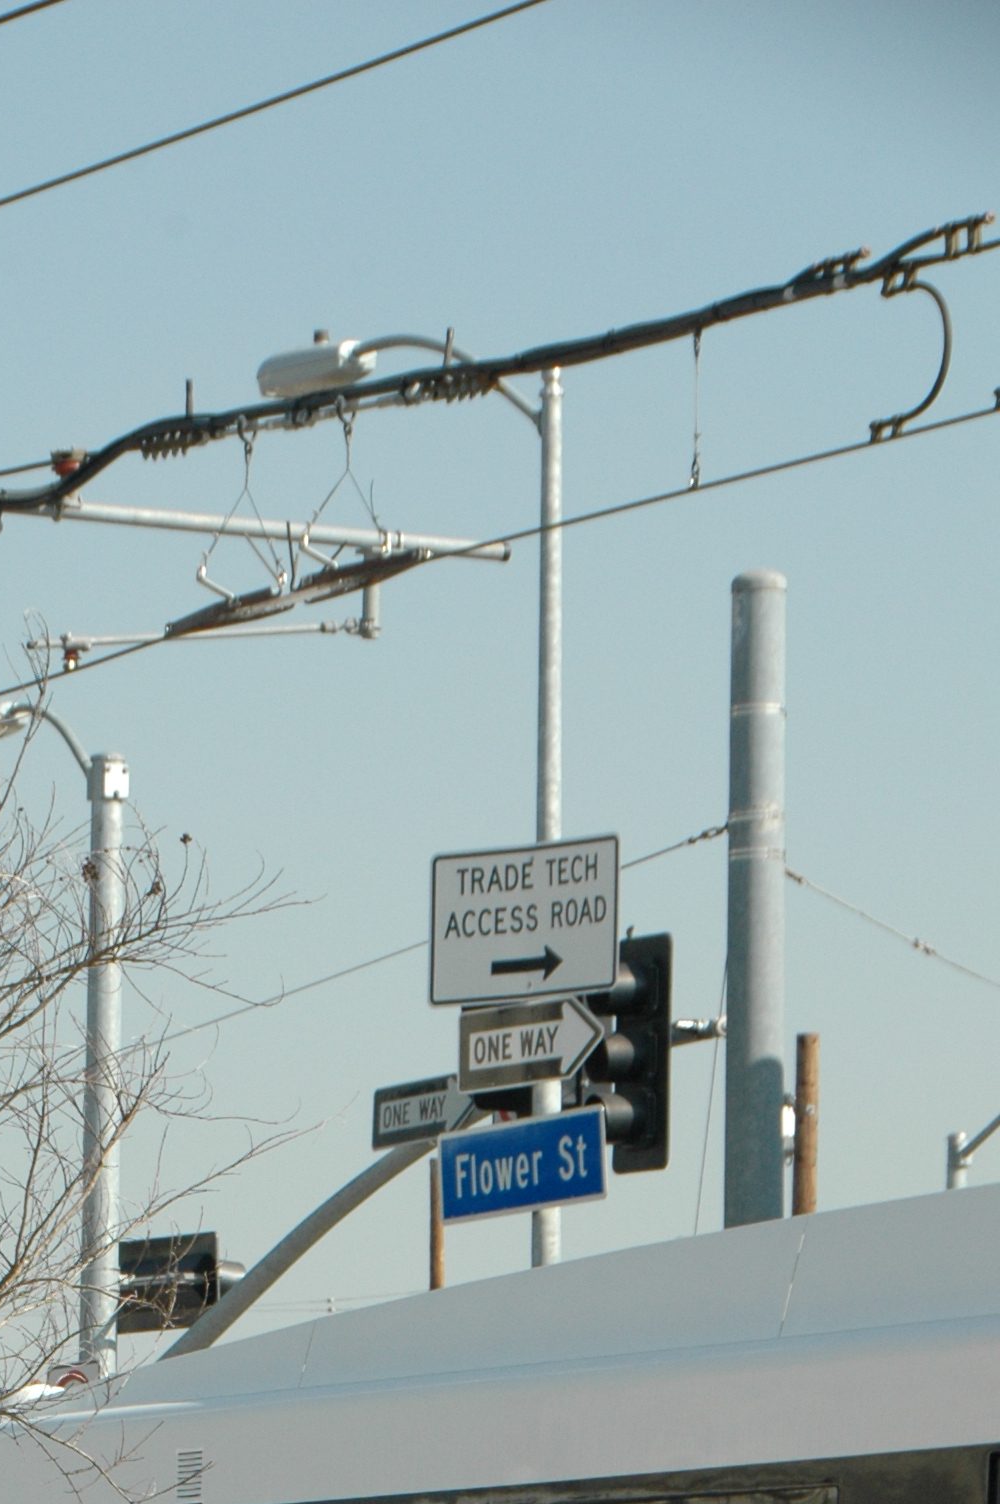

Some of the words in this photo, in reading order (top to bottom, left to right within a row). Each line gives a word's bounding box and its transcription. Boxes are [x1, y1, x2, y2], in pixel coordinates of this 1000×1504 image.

[457, 861, 534, 896] TRADE
[546, 853, 598, 886] TECH
[444, 903, 539, 940] ACCESS
[551, 895, 607, 928] ROAD
[473, 1032, 512, 1064] ONE
[520, 1025, 559, 1057] WAY
[383, 1101, 411, 1129] ONE
[419, 1095, 447, 1116] WAY
[455, 1150, 543, 1199] Flower
[559, 1134, 588, 1181] St
